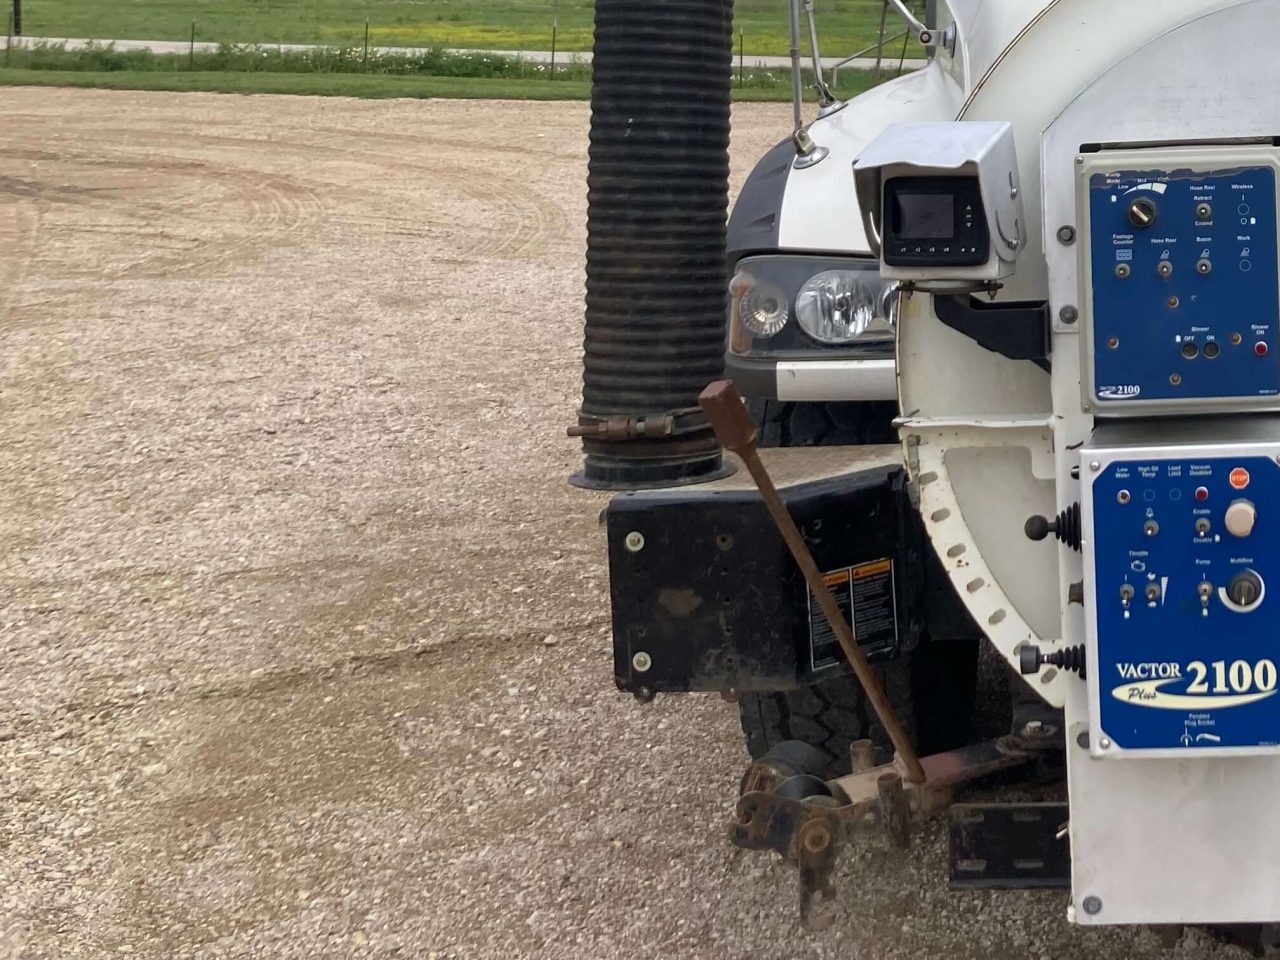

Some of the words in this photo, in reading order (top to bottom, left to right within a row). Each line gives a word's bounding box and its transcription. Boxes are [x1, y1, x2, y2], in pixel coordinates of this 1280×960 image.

[1117, 384, 1140, 394] 2100
[1116, 662, 1182, 678] VACTOR
[1186, 659, 1277, 694] 2100
[1128, 687, 1158, 700] Plus
